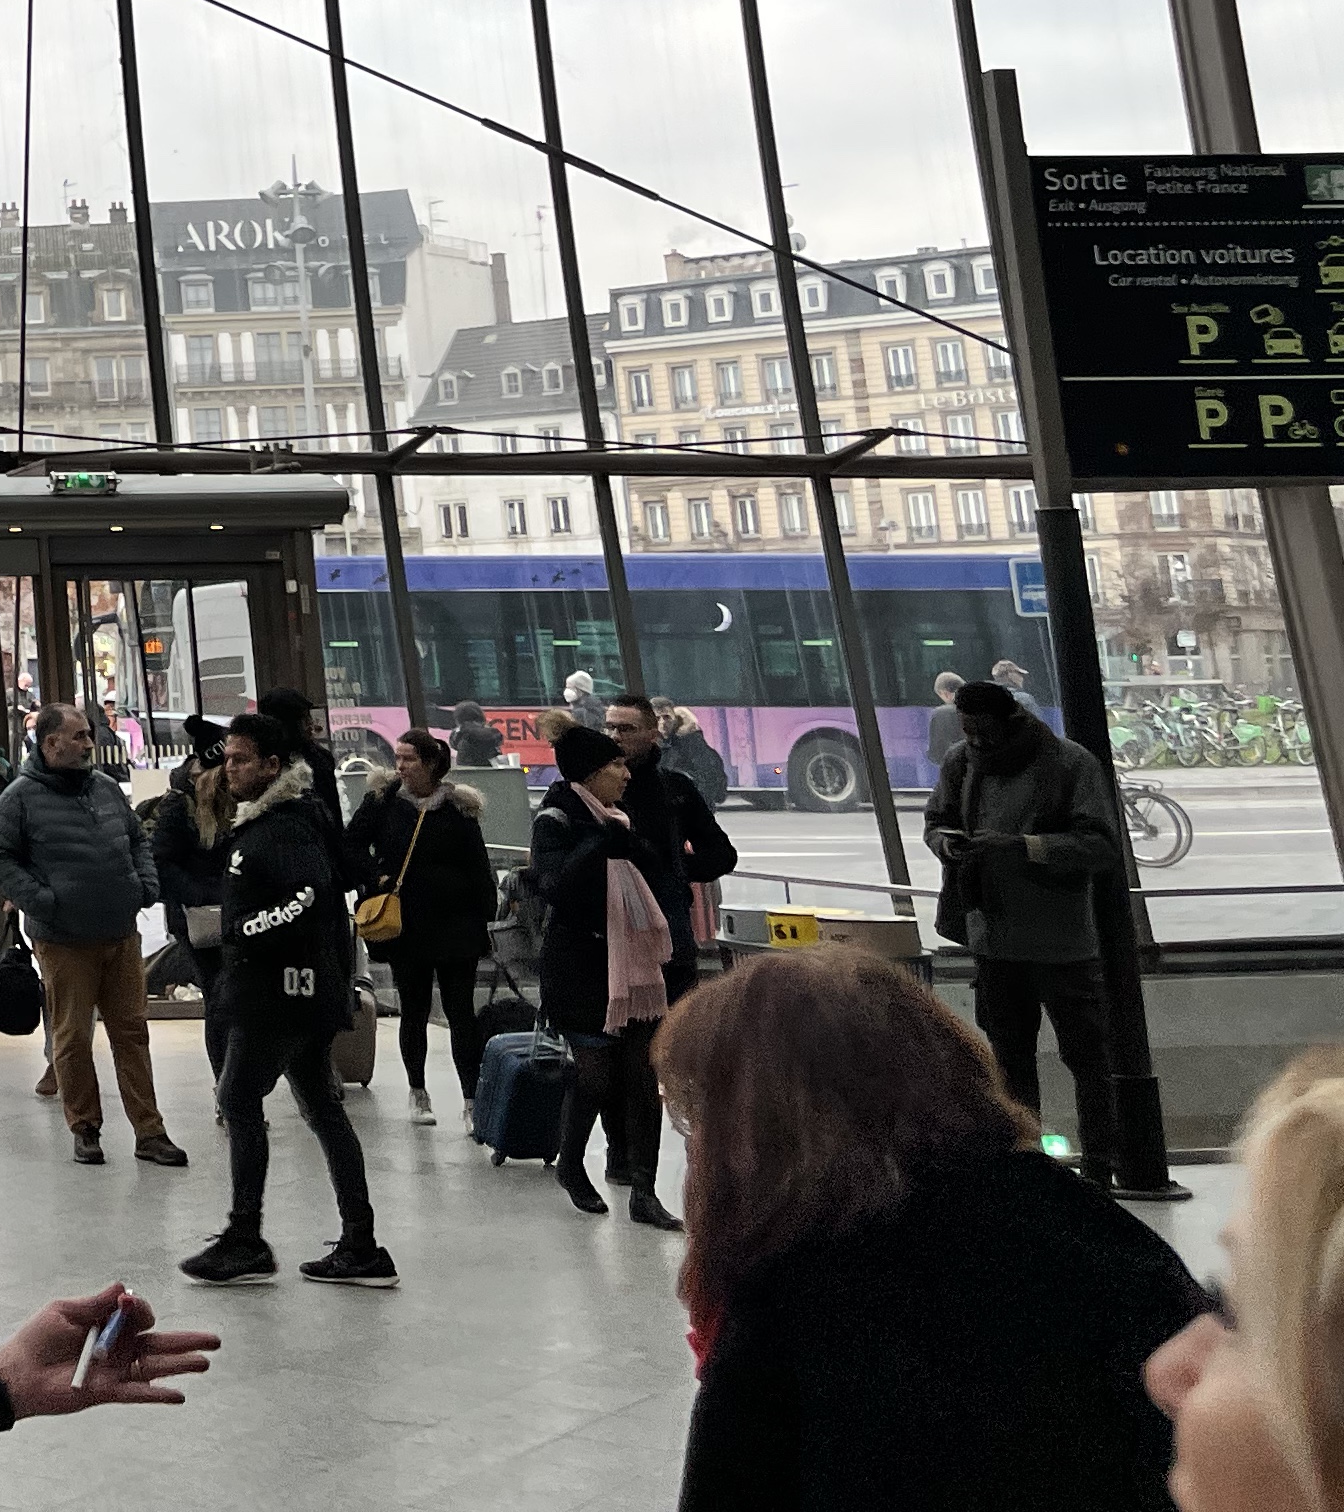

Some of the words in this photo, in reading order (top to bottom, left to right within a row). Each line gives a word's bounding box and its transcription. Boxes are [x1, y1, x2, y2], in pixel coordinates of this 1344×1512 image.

[1044, 168, 1128, 191] Sortie
[1196, 181, 1249, 194] France
[1093, 244, 1197, 265] Location
[1200, 244, 1296, 264] voitures
[243, 900, 304, 936] adidas
[283, 967, 315, 997] 03
